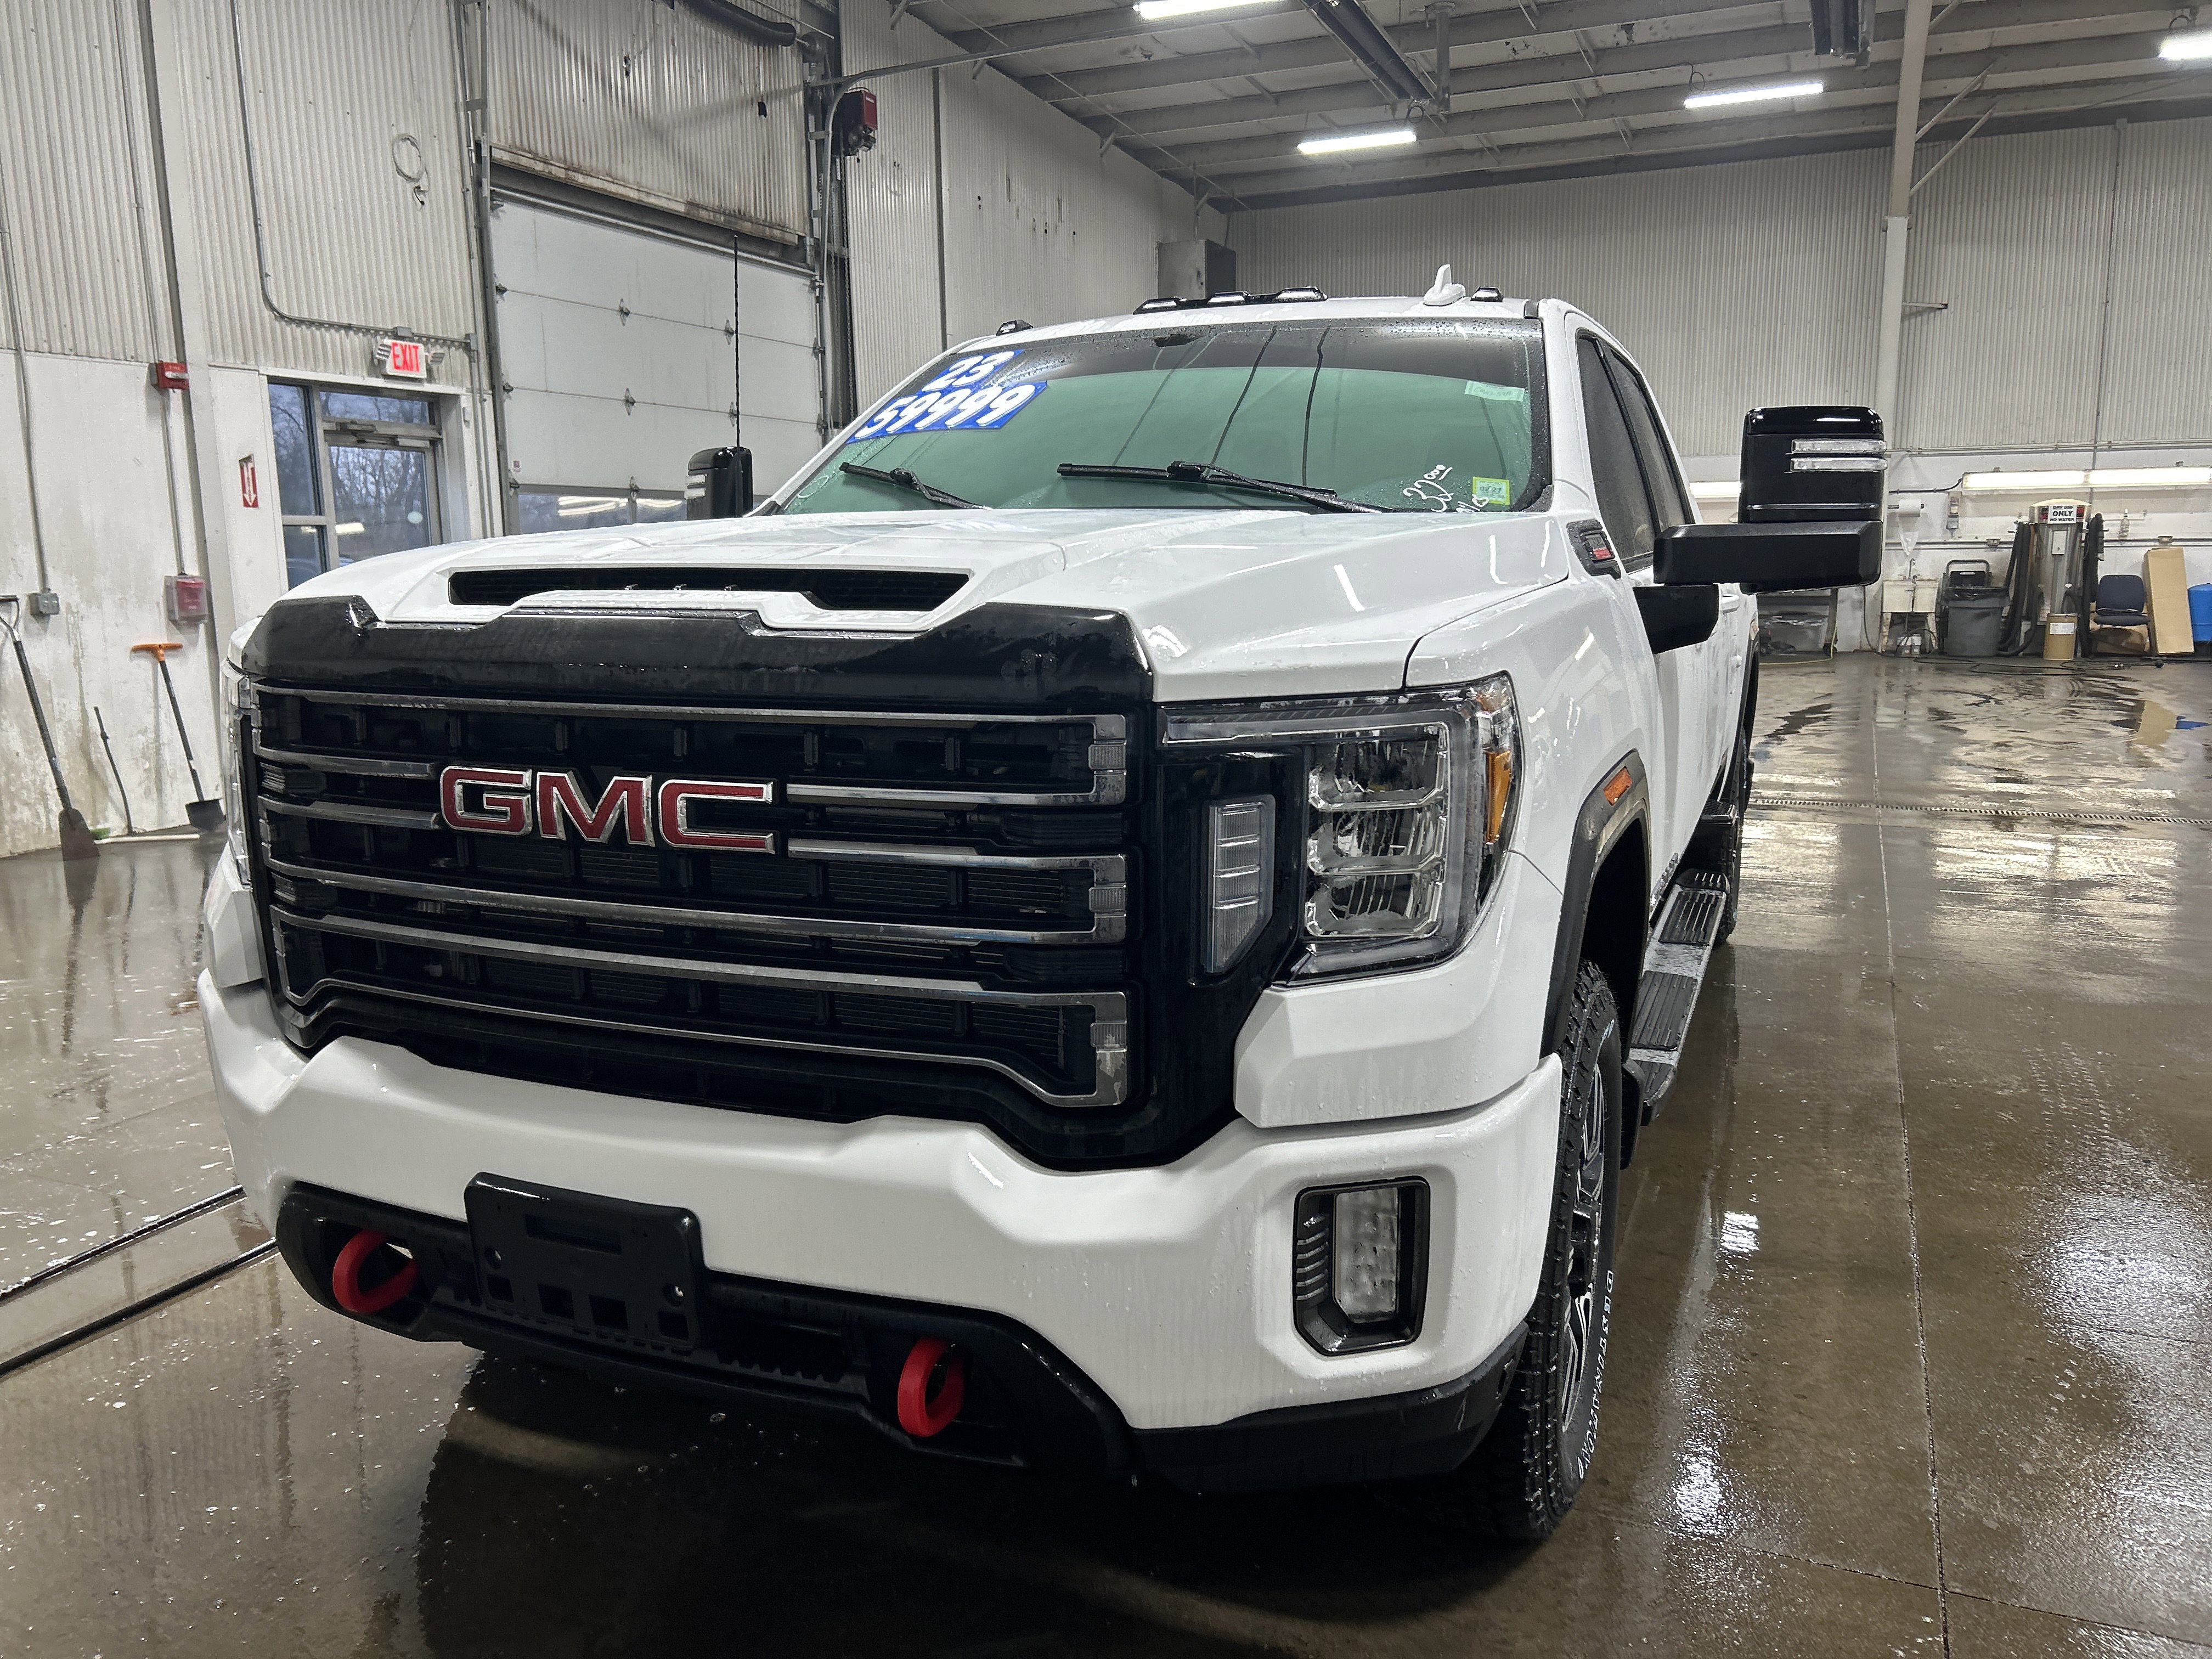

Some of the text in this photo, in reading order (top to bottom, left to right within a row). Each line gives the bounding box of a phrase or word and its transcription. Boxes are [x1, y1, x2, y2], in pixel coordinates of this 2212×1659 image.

[391, 342, 420, 373] EXIT
[922, 351, 1015, 392] 23
[854, 384, 1036, 439] 59999
[439, 765, 776, 855] GMC
[1582, 1269, 1614, 1469] DESTINATION
